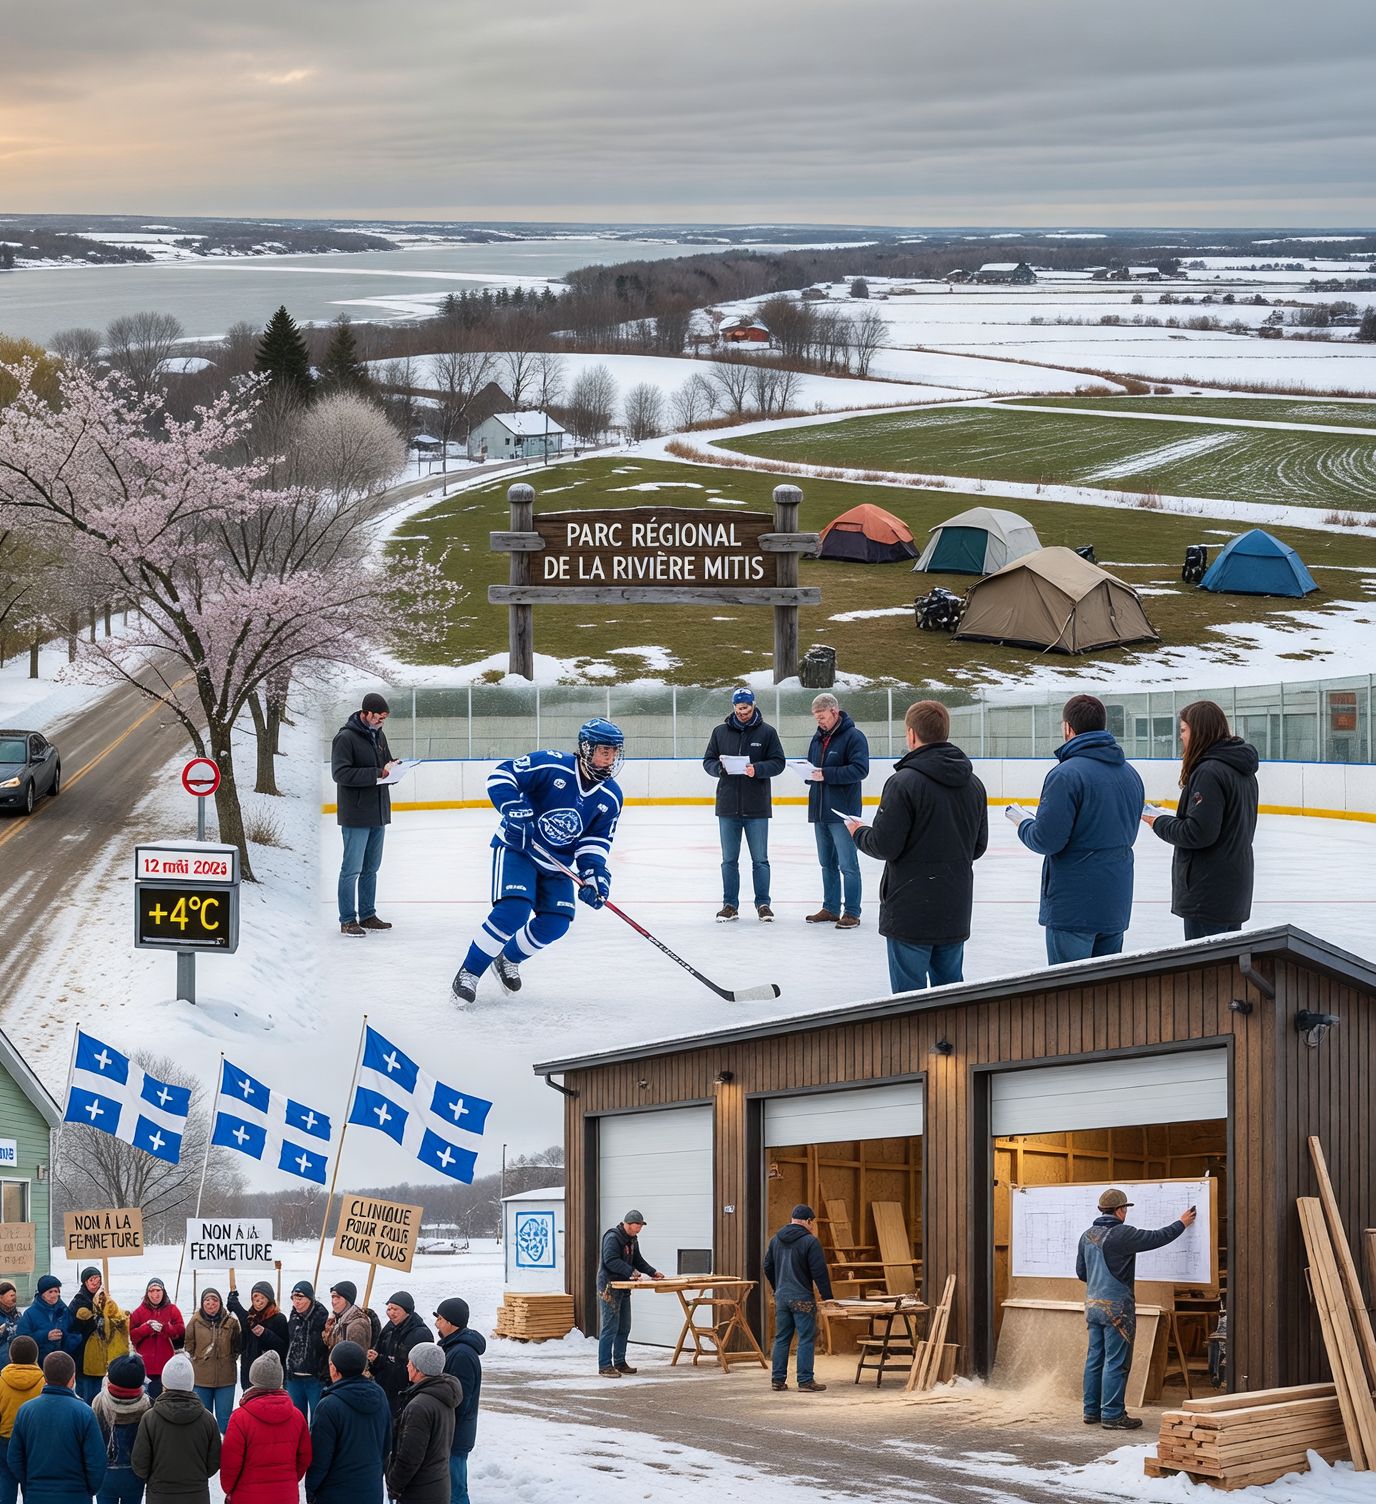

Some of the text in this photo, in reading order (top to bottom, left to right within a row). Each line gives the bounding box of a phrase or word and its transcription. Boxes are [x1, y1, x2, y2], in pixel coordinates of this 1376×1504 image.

[567, 517, 742, 547] PARC RÉGIONAL
[544, 551, 765, 580] DE LA RIVIÈRE MITIS
[144, 859, 160, 873] 12
[148, 896, 220, 931] +4°C
[74, 1215, 101, 1231] NON
[116, 1214, 131, 1230] LA
[202, 1223, 231, 1240] NON
[190, 1242, 273, 1261] FERMETURE
[339, 1234, 371, 1255] POUR
[376, 1241, 408, 1263] TOUS
